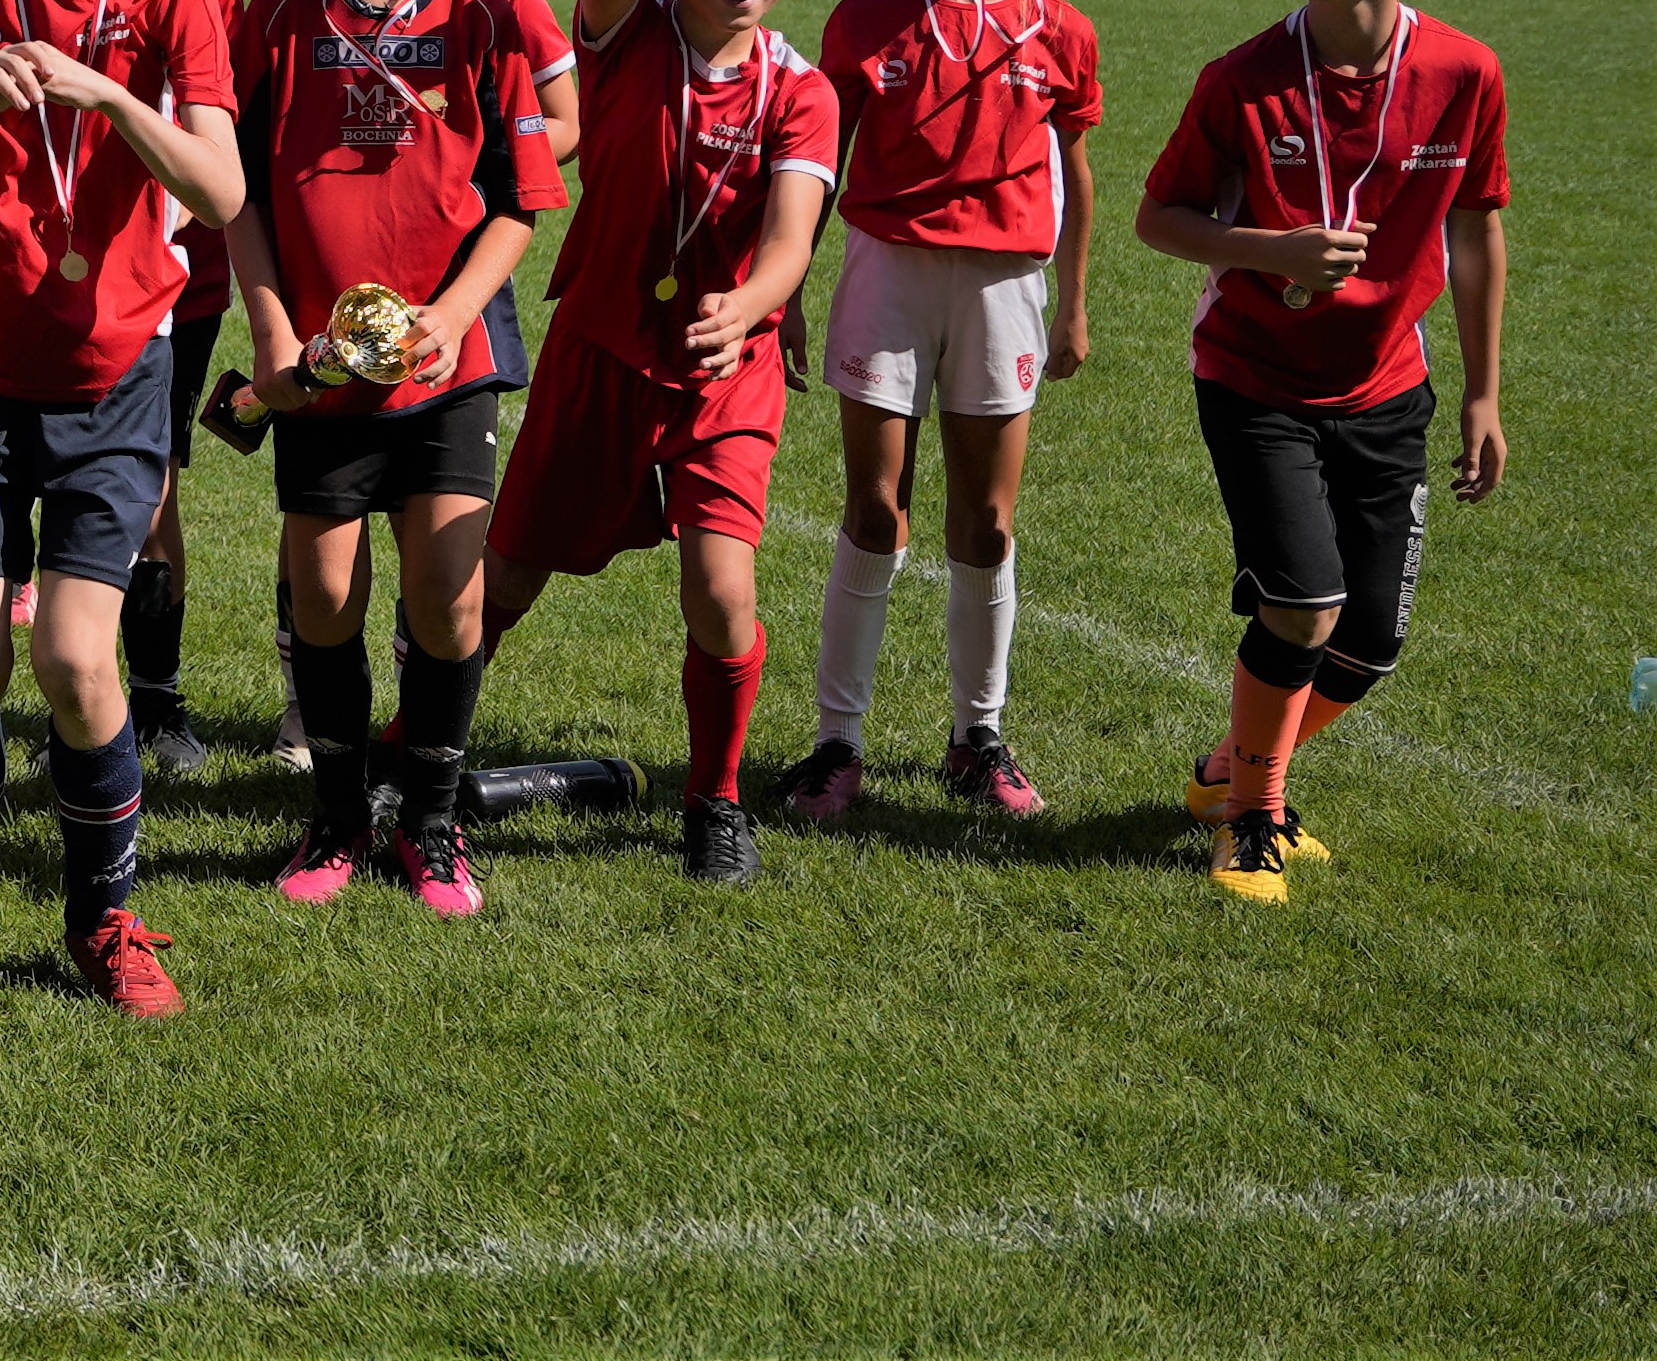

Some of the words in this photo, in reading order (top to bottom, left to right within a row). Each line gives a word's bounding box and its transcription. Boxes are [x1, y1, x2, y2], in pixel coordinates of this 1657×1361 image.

[342, 131, 414, 141] BOCHNIA
[1411, 141, 1458, 156] Zostań
[1400, 157, 1467, 171] Piłkarzem
[1394, 537, 1423, 638] ENDLESS
